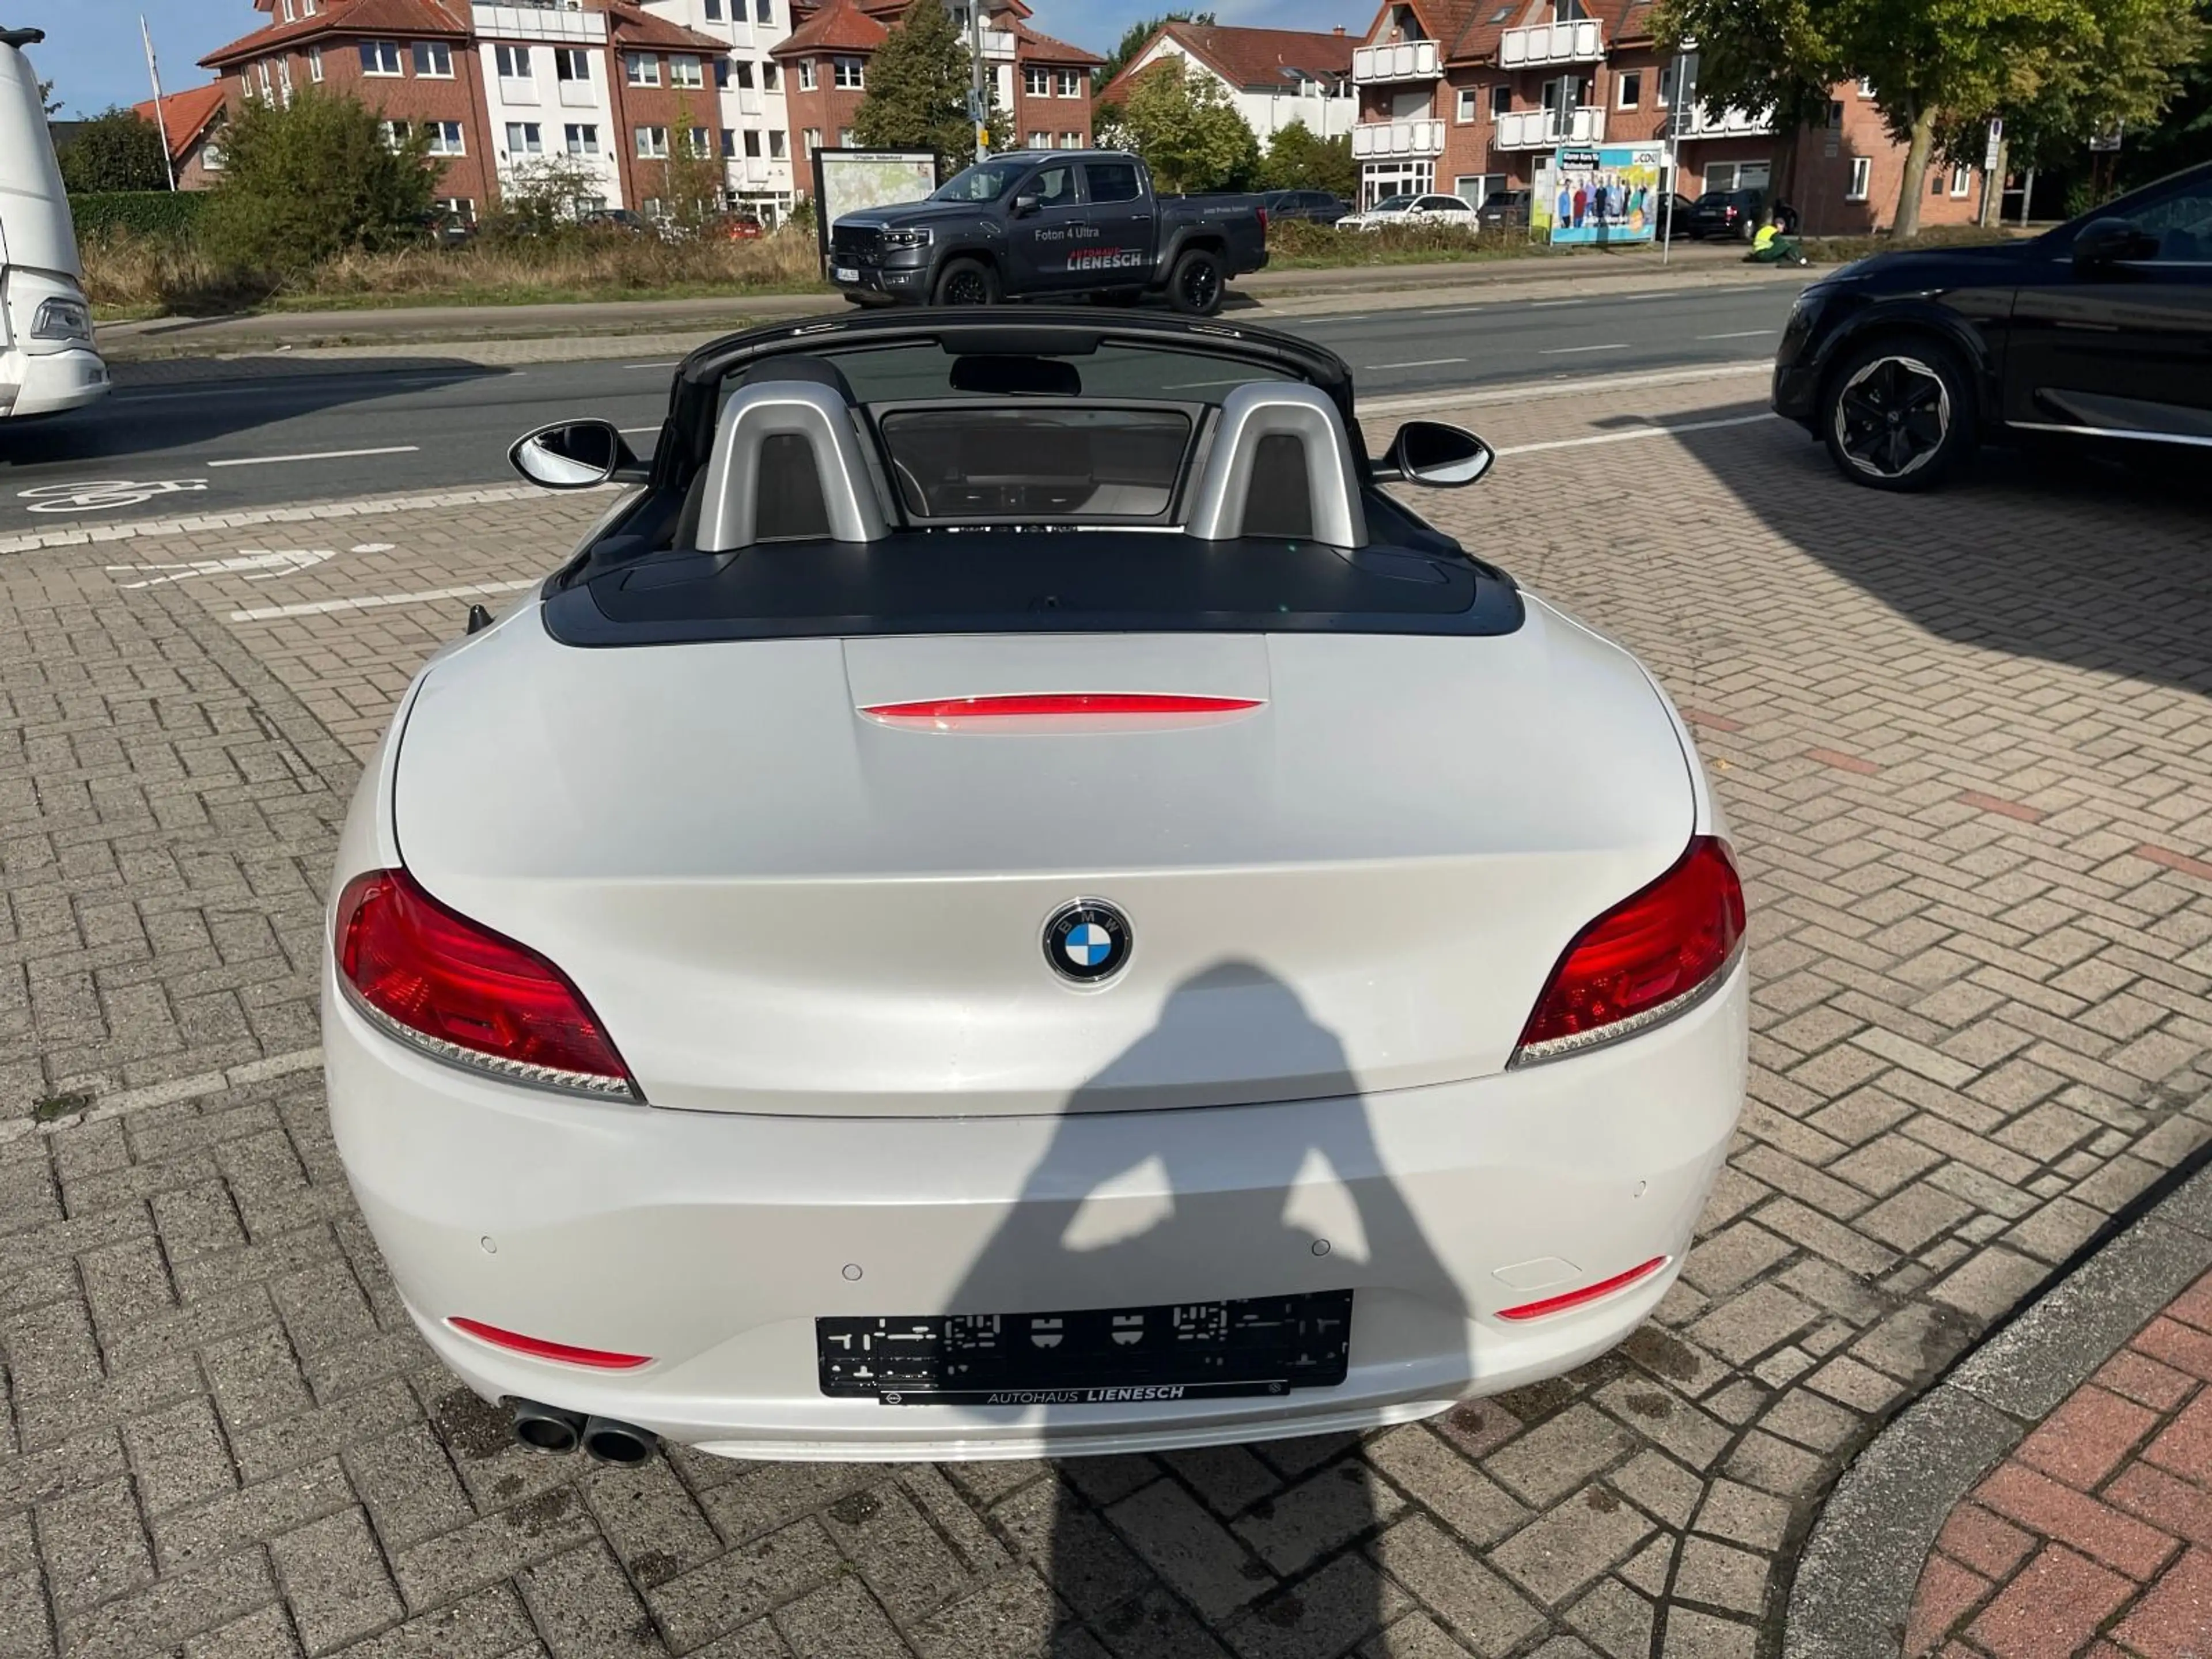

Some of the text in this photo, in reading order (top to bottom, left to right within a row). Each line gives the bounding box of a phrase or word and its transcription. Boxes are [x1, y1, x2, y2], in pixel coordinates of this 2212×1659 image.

[1639, 153, 1657, 163] CDU
[1035, 226, 1100, 241] Foton 4 Ultra
[1067, 253, 1142, 271] LIENESCH
[1058, 911, 1120, 934] BMW
[987, 1386, 1185, 1404] AUTOHAUS LIENESCH
